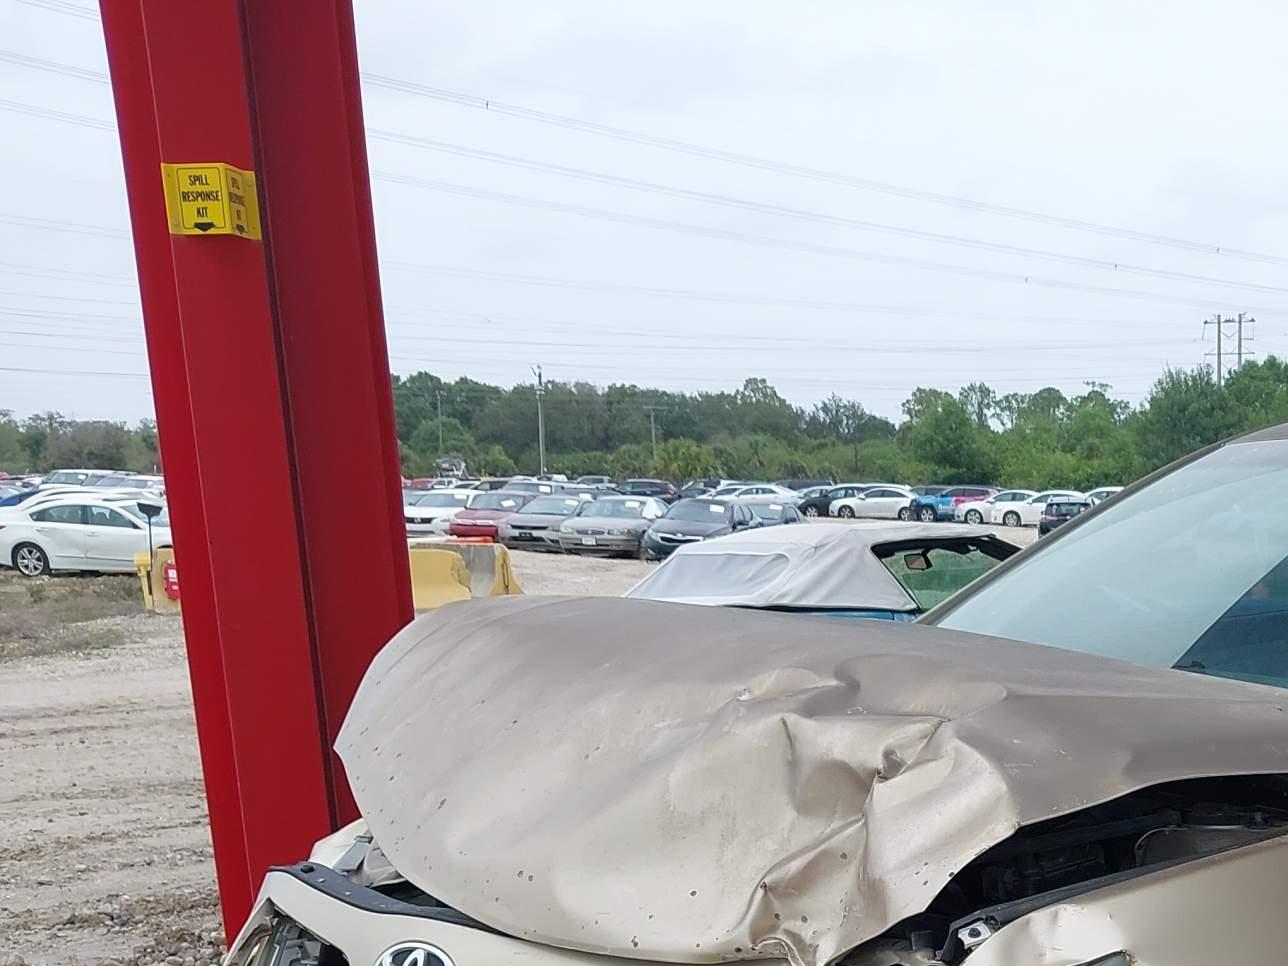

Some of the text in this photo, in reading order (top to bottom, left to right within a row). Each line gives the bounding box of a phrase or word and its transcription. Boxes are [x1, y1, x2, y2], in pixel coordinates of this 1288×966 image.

[188, 175, 210, 186] SPILL
[182, 190, 221, 203] RESPONSE
[196, 207, 209, 218] KIT
